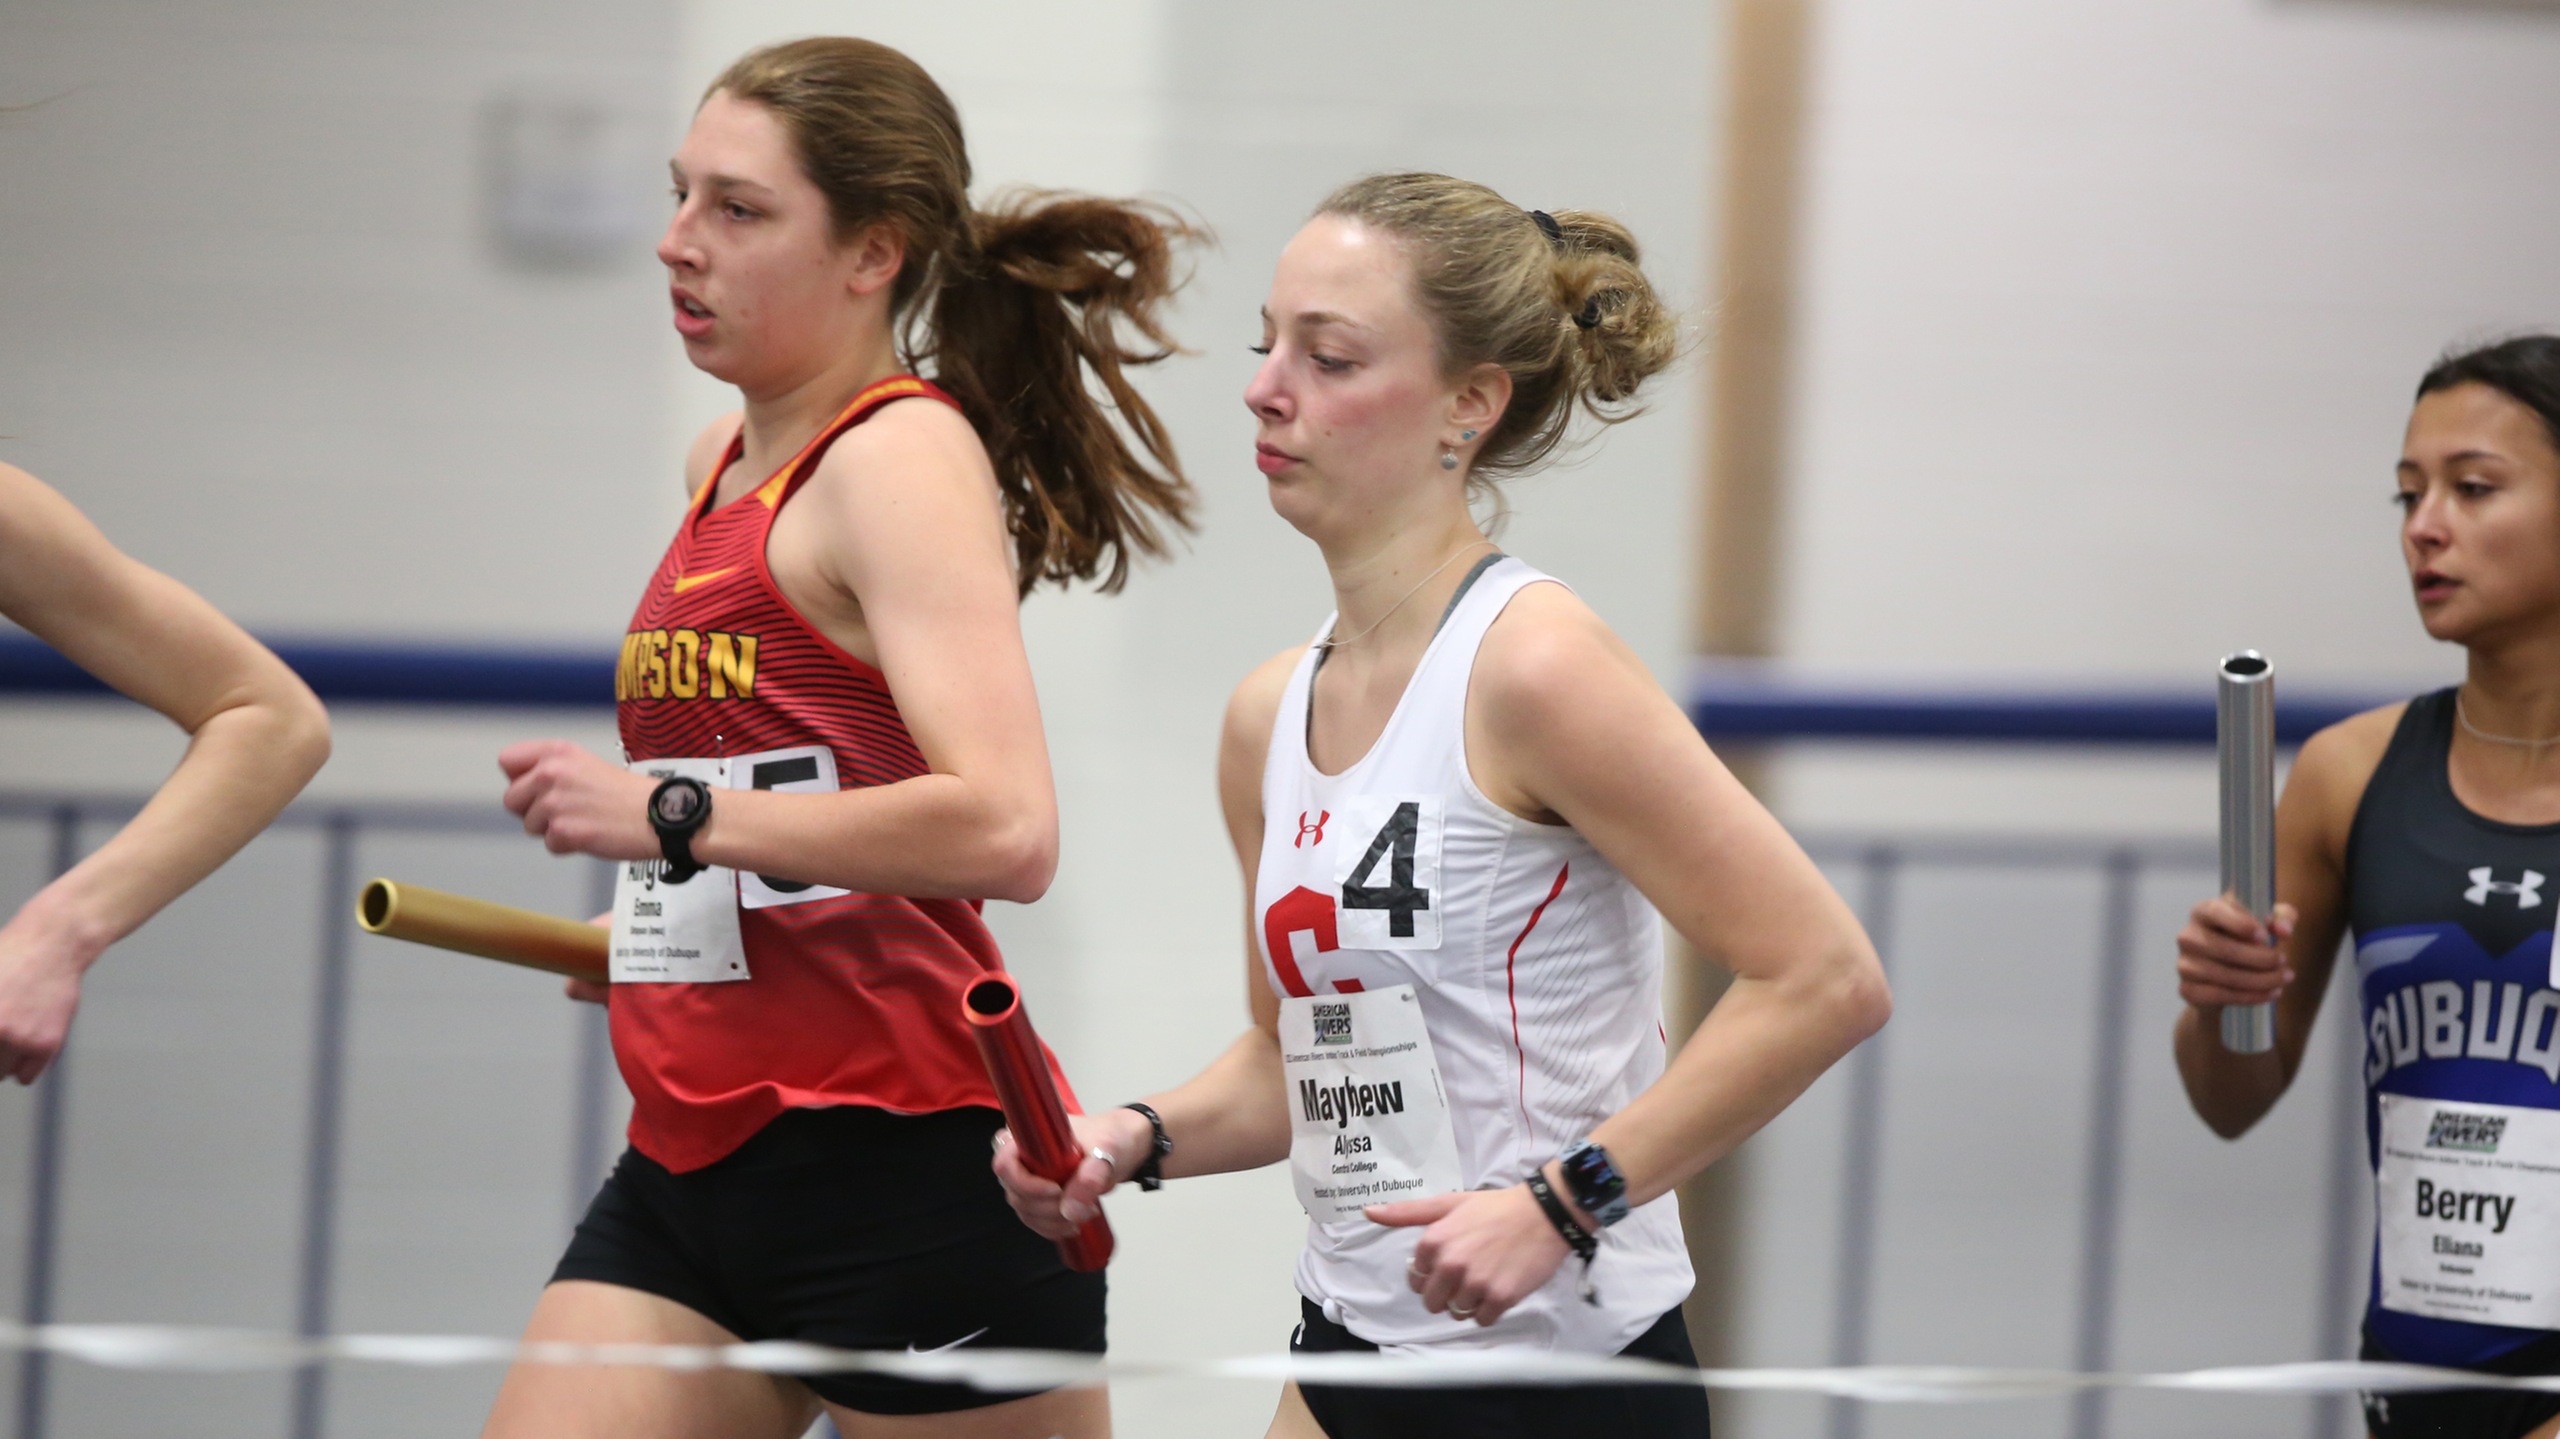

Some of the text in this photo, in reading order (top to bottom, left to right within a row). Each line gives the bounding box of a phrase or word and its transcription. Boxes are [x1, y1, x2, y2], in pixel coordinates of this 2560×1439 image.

[1342, 802, 1429, 938] 4
[1299, 1075, 1404, 1129] Mayhew
[1350, 1161, 1378, 1173] College
[1371, 1182, 1381, 1194] of
[1381, 1177, 1424, 1192] Dubuque
[2417, 1178, 2515, 1234] Berry
